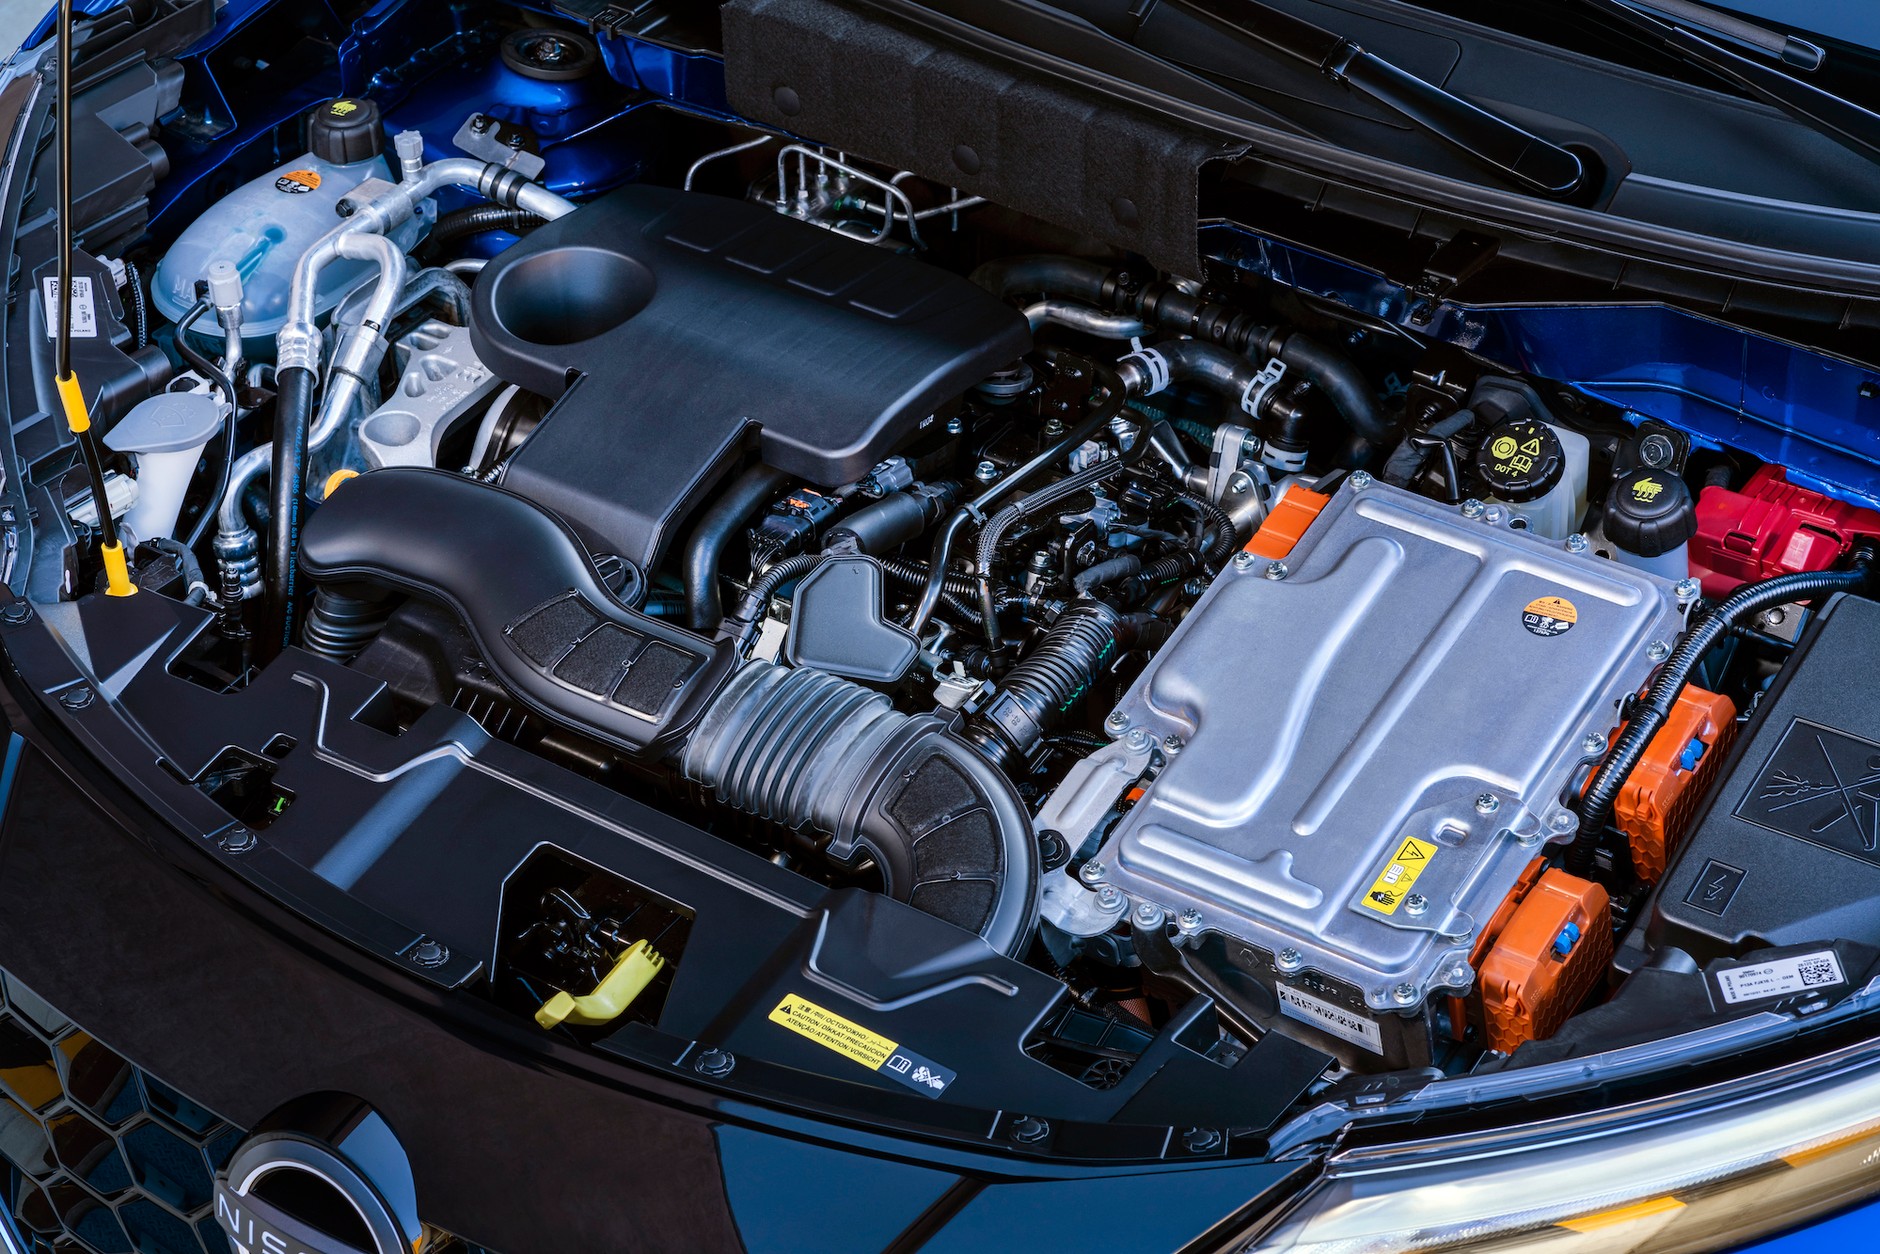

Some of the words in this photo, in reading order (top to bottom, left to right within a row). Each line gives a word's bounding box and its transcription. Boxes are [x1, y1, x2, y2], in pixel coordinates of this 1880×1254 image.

[294, 426, 304, 470] GALAXY
[292, 473, 300, 494] 4886
[1494, 463, 1512, 475] DOT
[1511, 470, 1519, 478] 4
[287, 551, 298, 597] Flexbarrier
[792, 1010, 819, 1026] CAUTION
[815, 1030, 850, 1050] ATTENTION
[850, 1048, 881, 1065] VORSICHT
[219, 1193, 305, 1254] NIS
